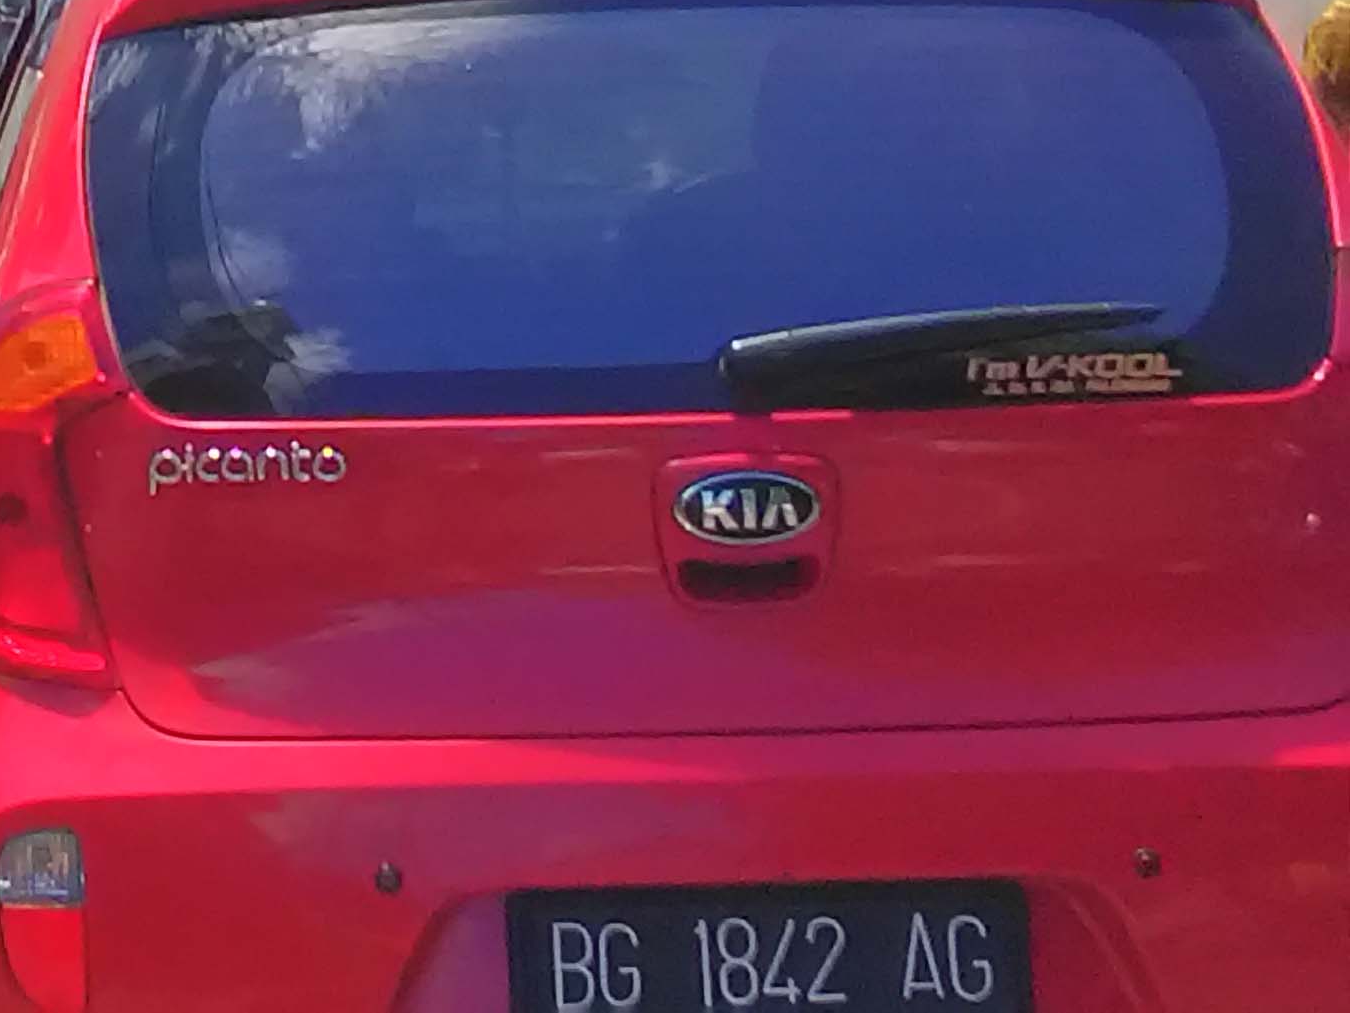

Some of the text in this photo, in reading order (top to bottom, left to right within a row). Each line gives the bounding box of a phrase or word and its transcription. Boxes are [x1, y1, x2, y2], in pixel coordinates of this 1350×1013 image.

[150, 441, 348, 497] picanto
[699, 487, 798, 531] KIA
[551, 910, 996, 1010] BG 1842 AG
